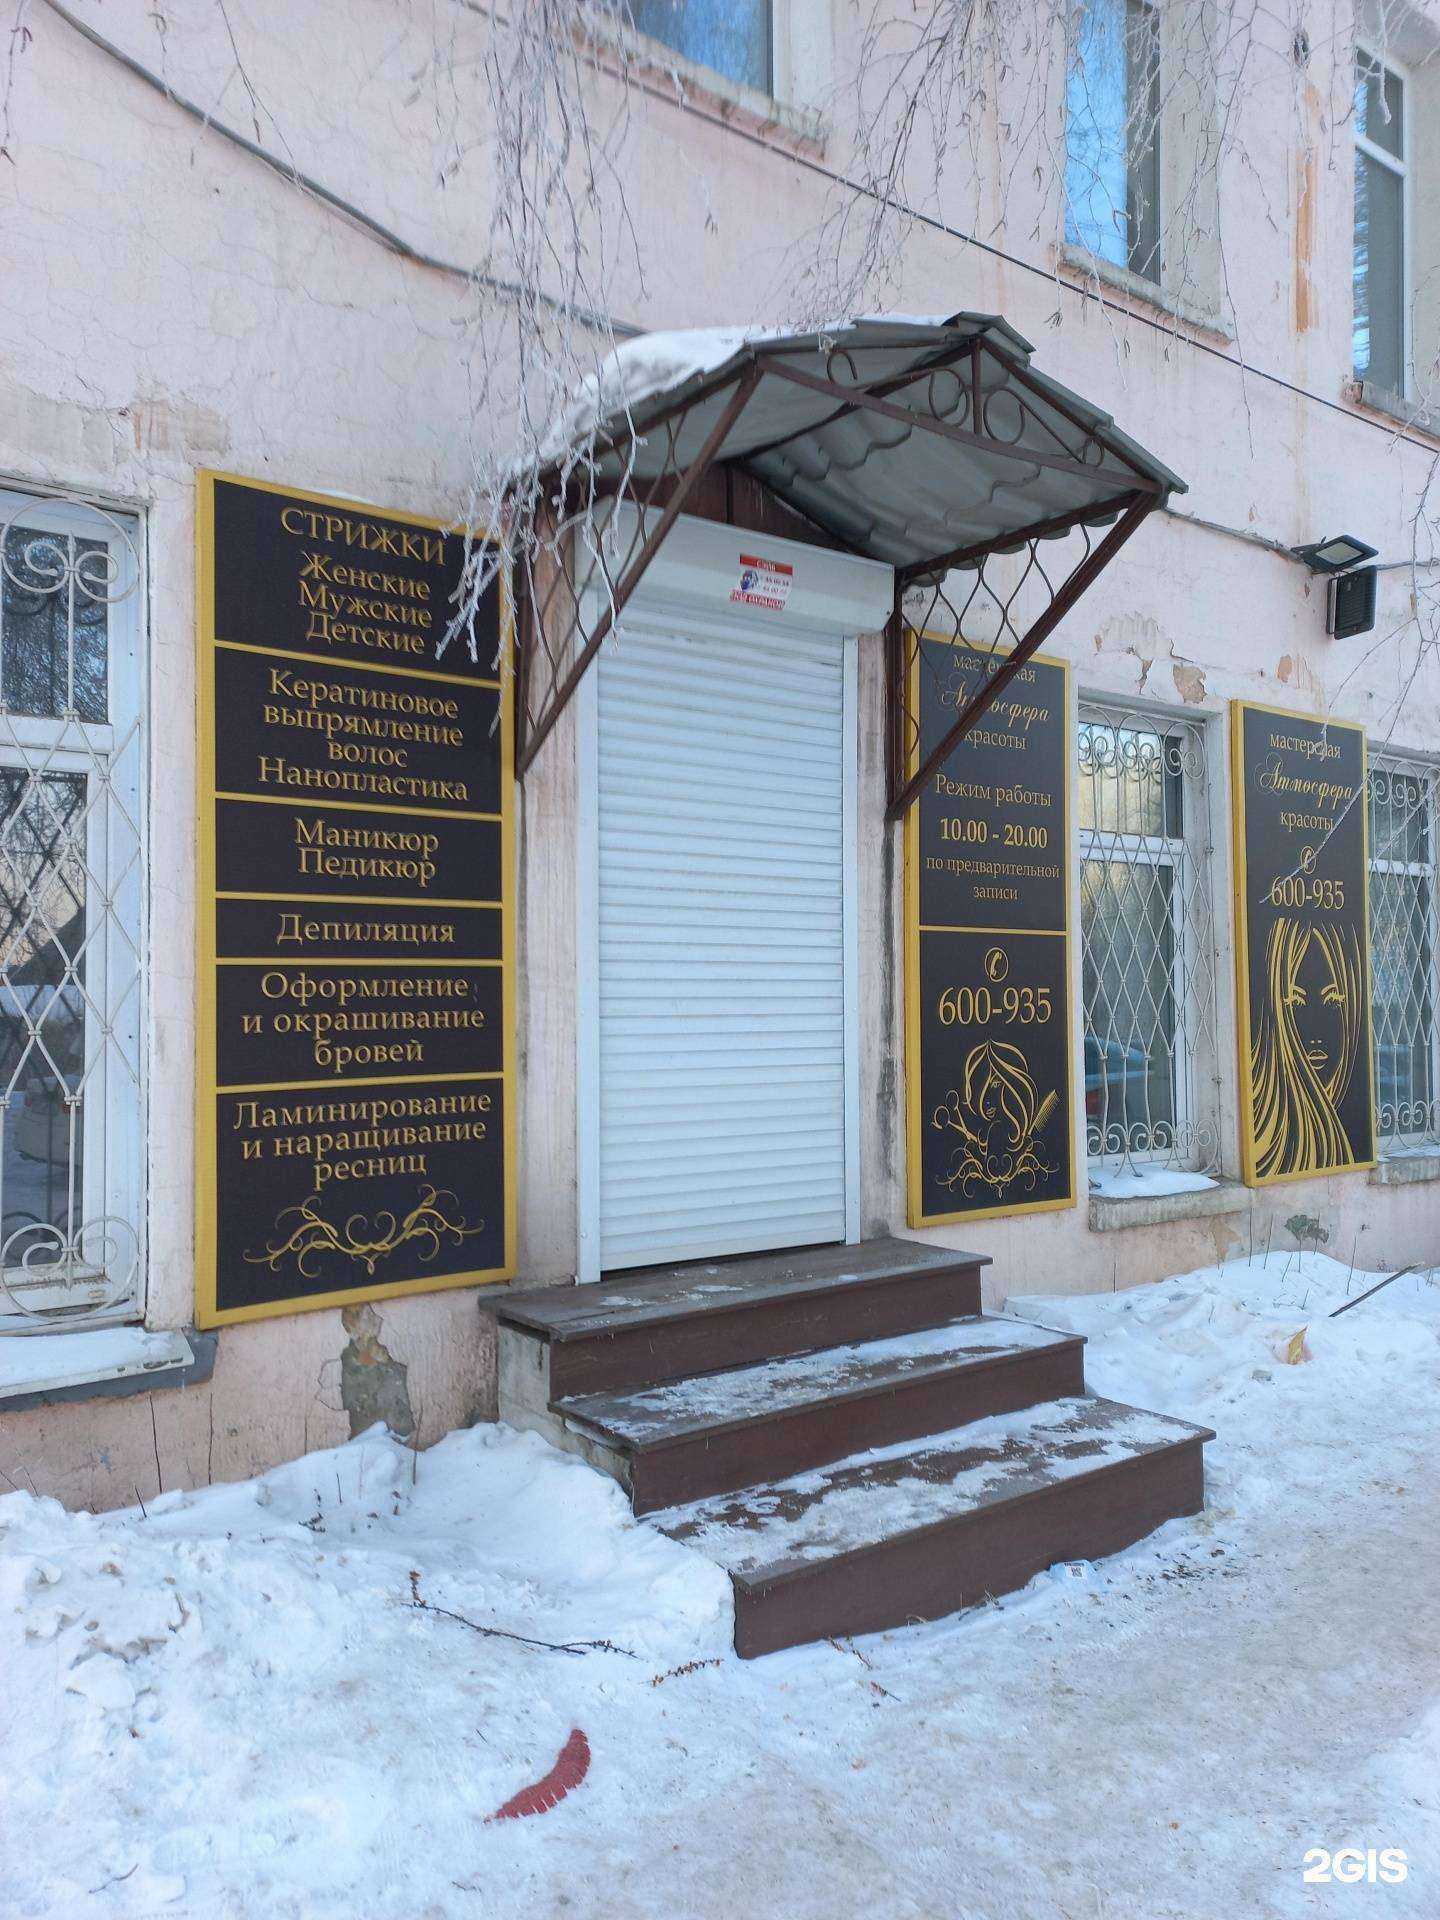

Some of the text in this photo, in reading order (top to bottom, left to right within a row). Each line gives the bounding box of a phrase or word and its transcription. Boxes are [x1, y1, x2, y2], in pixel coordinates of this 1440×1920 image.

[280, 506, 446, 566] СТРИЖКИ
[301, 551, 431, 600] Женские
[299, 580, 432, 629] Мужские
[305, 611, 425, 655] Детские
[269, 667, 460, 720] Кератиновое
[263, 703, 464, 747] выпрямление
[328, 738, 409, 768] волос
[257, 755, 468, 801] Нанопластика
[935, 773, 1052, 808] Режим работы
[1256, 753, 1352, 810] Атмосфера
[294, 816, 440, 859] Маникюр
[940, 818, 987, 843] 10.00
[1004, 823, 1048, 848] 20.00
[1281, 811, 1333, 833] красоты
[298, 847, 437, 888] Педикюр
[926, 856, 1060, 879] по предварительной
[973, 884, 1019, 901] записи
[1271, 875, 1345, 910] 600-935
[276, 912, 456, 947] Депиляция
[260, 970, 469, 1007] Оформление
[939, 987, 1052, 1026] 600-935
[242, 1007, 486, 1040] и окрашивание
[313, 1038, 425, 1074] бровей
[233, 1091, 492, 1130] Ламинирование
[241, 1120, 487, 1160] и наращивание
[313, 1151, 428, 1192] ресниц
